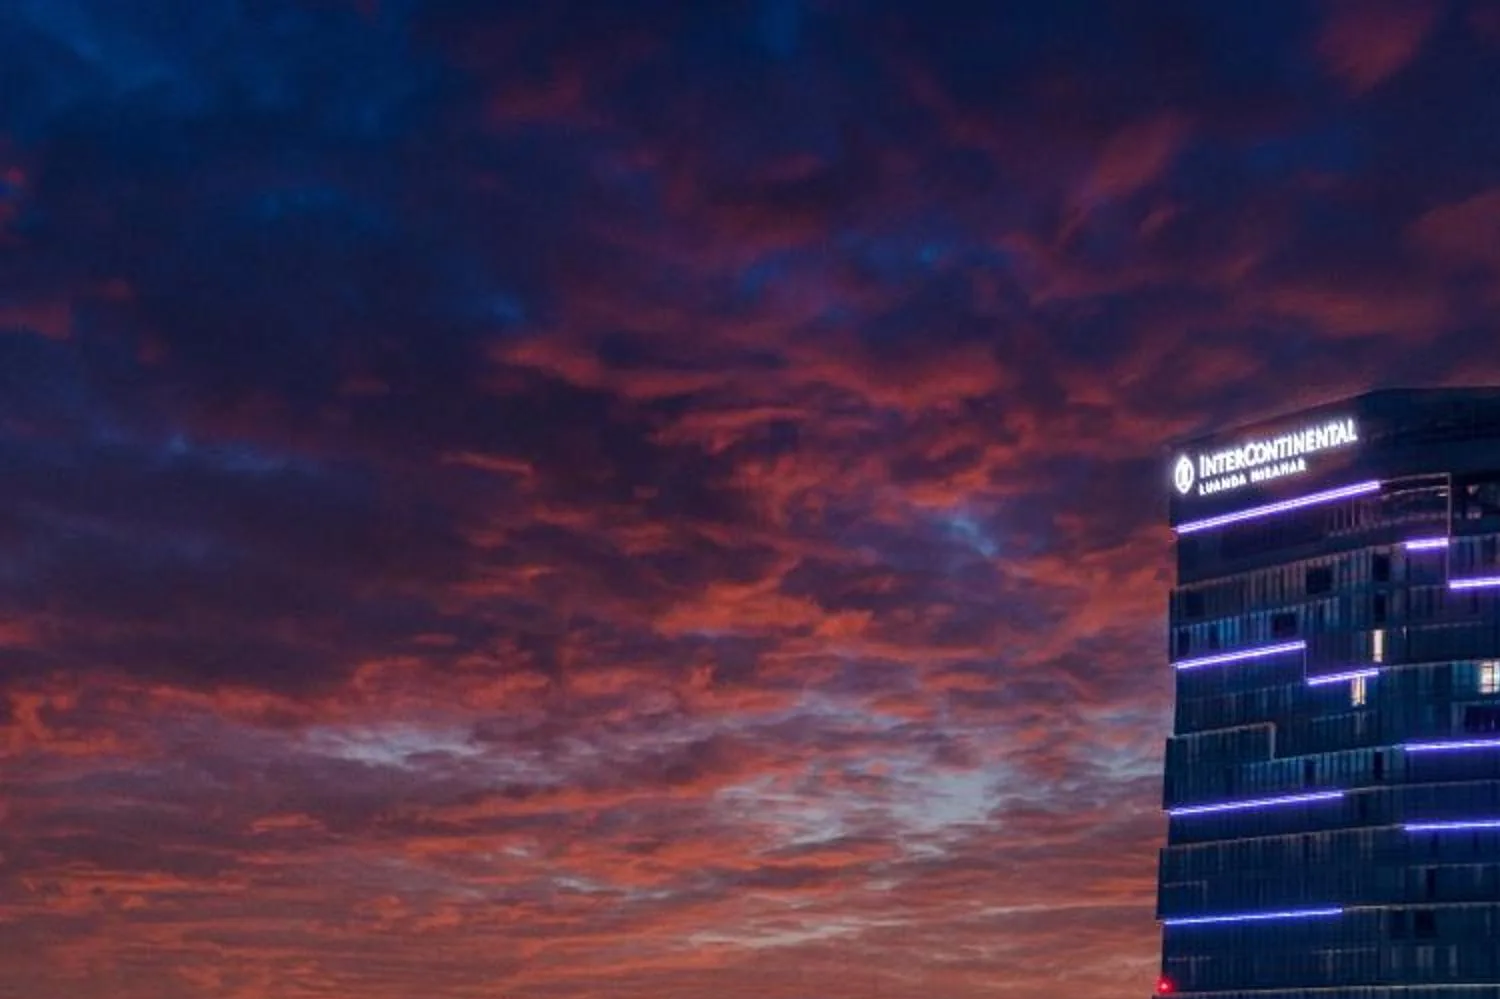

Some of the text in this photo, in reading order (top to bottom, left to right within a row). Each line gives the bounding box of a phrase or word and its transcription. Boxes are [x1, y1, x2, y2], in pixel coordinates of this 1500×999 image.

[1199, 418, 1358, 478] INTERCONTINENTAL
[1200, 458, 1306, 496] LUANDA MIRAMAR
